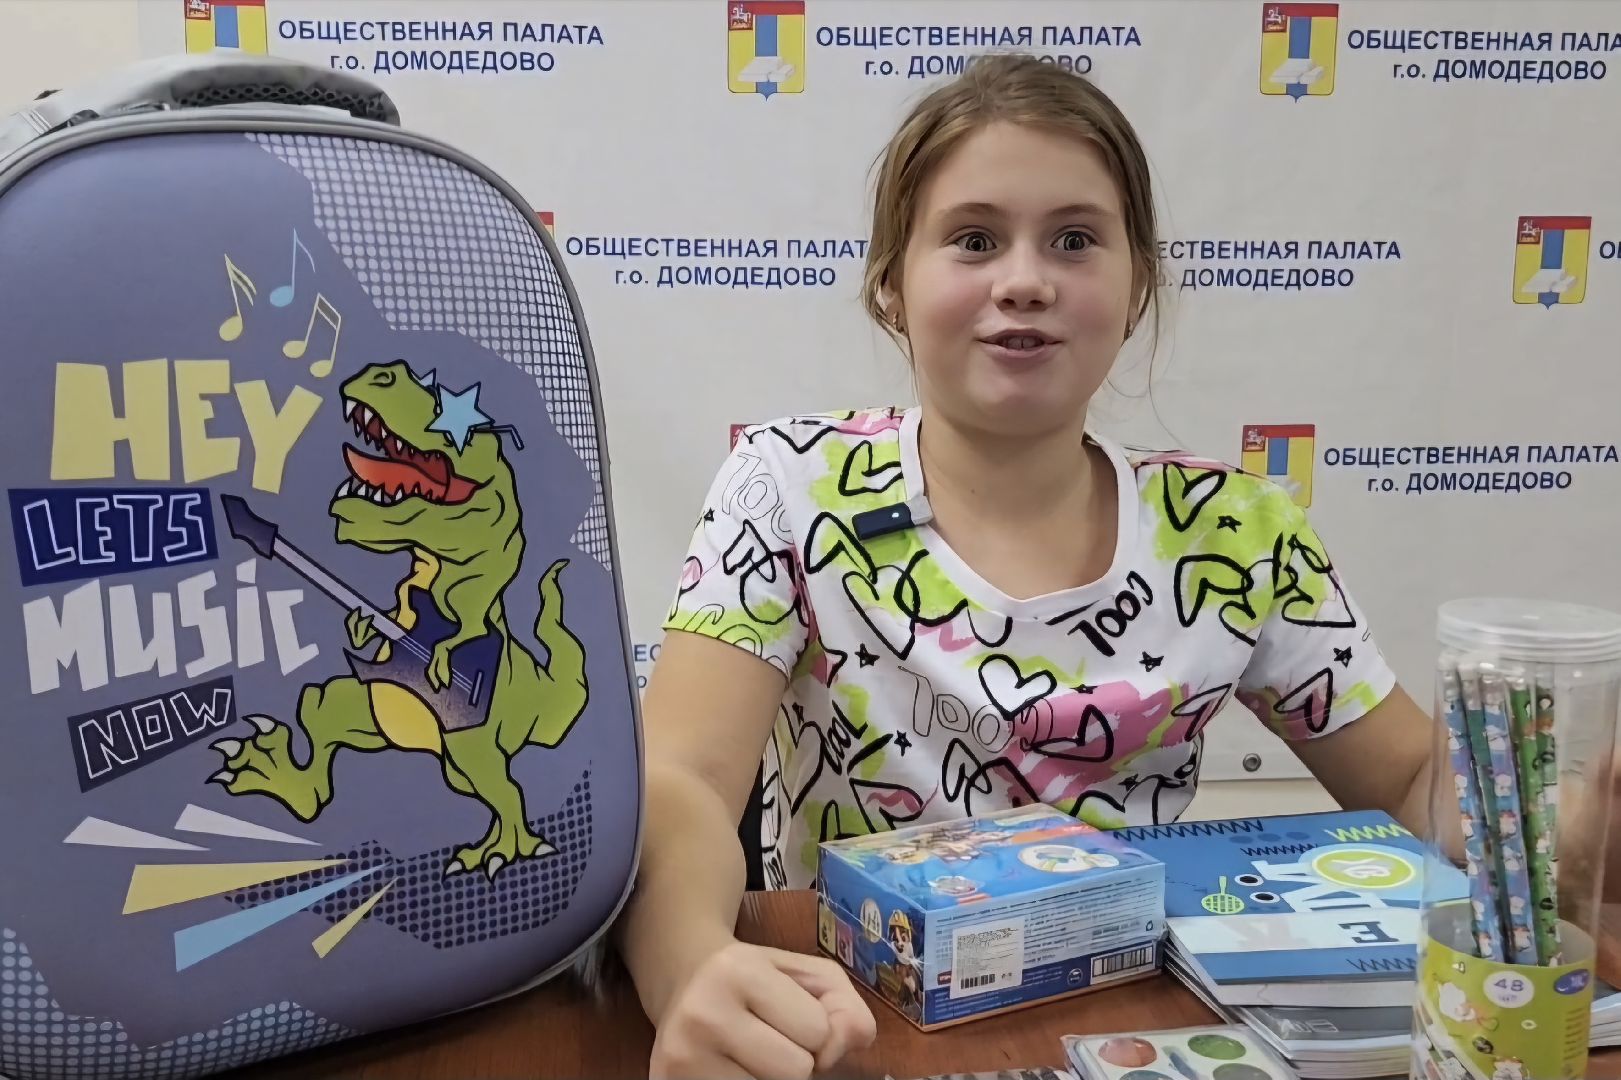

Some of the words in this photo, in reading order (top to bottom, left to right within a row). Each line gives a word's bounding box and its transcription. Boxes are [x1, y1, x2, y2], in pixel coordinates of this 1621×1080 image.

[278, 19, 493, 44] ОБЩЕСТВЕННАЯ
[502, 22, 605, 46] ПАЛАТА
[815, 26, 1033, 48] ОБЩЕСТВЕННАЯ
[1041, 26, 1142, 47] ПАЛАТА
[1347, 29, 1553, 54] ОБЩЕСТВЕННАЯ
[1560, 32, 1621, 52] ПАЛА
[330, 55, 366, 71] г.о.
[373, 50, 555, 75] ДОМОДЕДОВО
[864, 60, 900, 76] г.о.
[1393, 63, 1426, 79] г.о.
[1432, 59, 1607, 84] ДОМОДЕДОВО
[565, 236, 778, 261] ОБЩЕСТВЕННАЯ
[787, 239, 869, 259] ПАЛАТ
[1156, 239, 1299, 260] ЕСТВЕННАЯ
[1307, 240, 1401, 260] ПАЛАТА
[615, 269, 649, 285] г.о.
[656, 265, 836, 290] ДОМОДЕДОВО
[1180, 268, 1355, 291] ДОМОДЕДОВО
[50, 358, 324, 494] HEY
[1323, 445, 1520, 468] ОБЩЕСТВЕННАЯ
[1526, 444, 1620, 464] ПАЛАТА
[1367, 478, 1399, 493] г.о.
[1405, 470, 1573, 496] ДОМОДЕДОВО
[23, 494, 208, 571] LETS
[78, 688, 232, 779] NOW
[1493, 978, 1525, 992] 48
